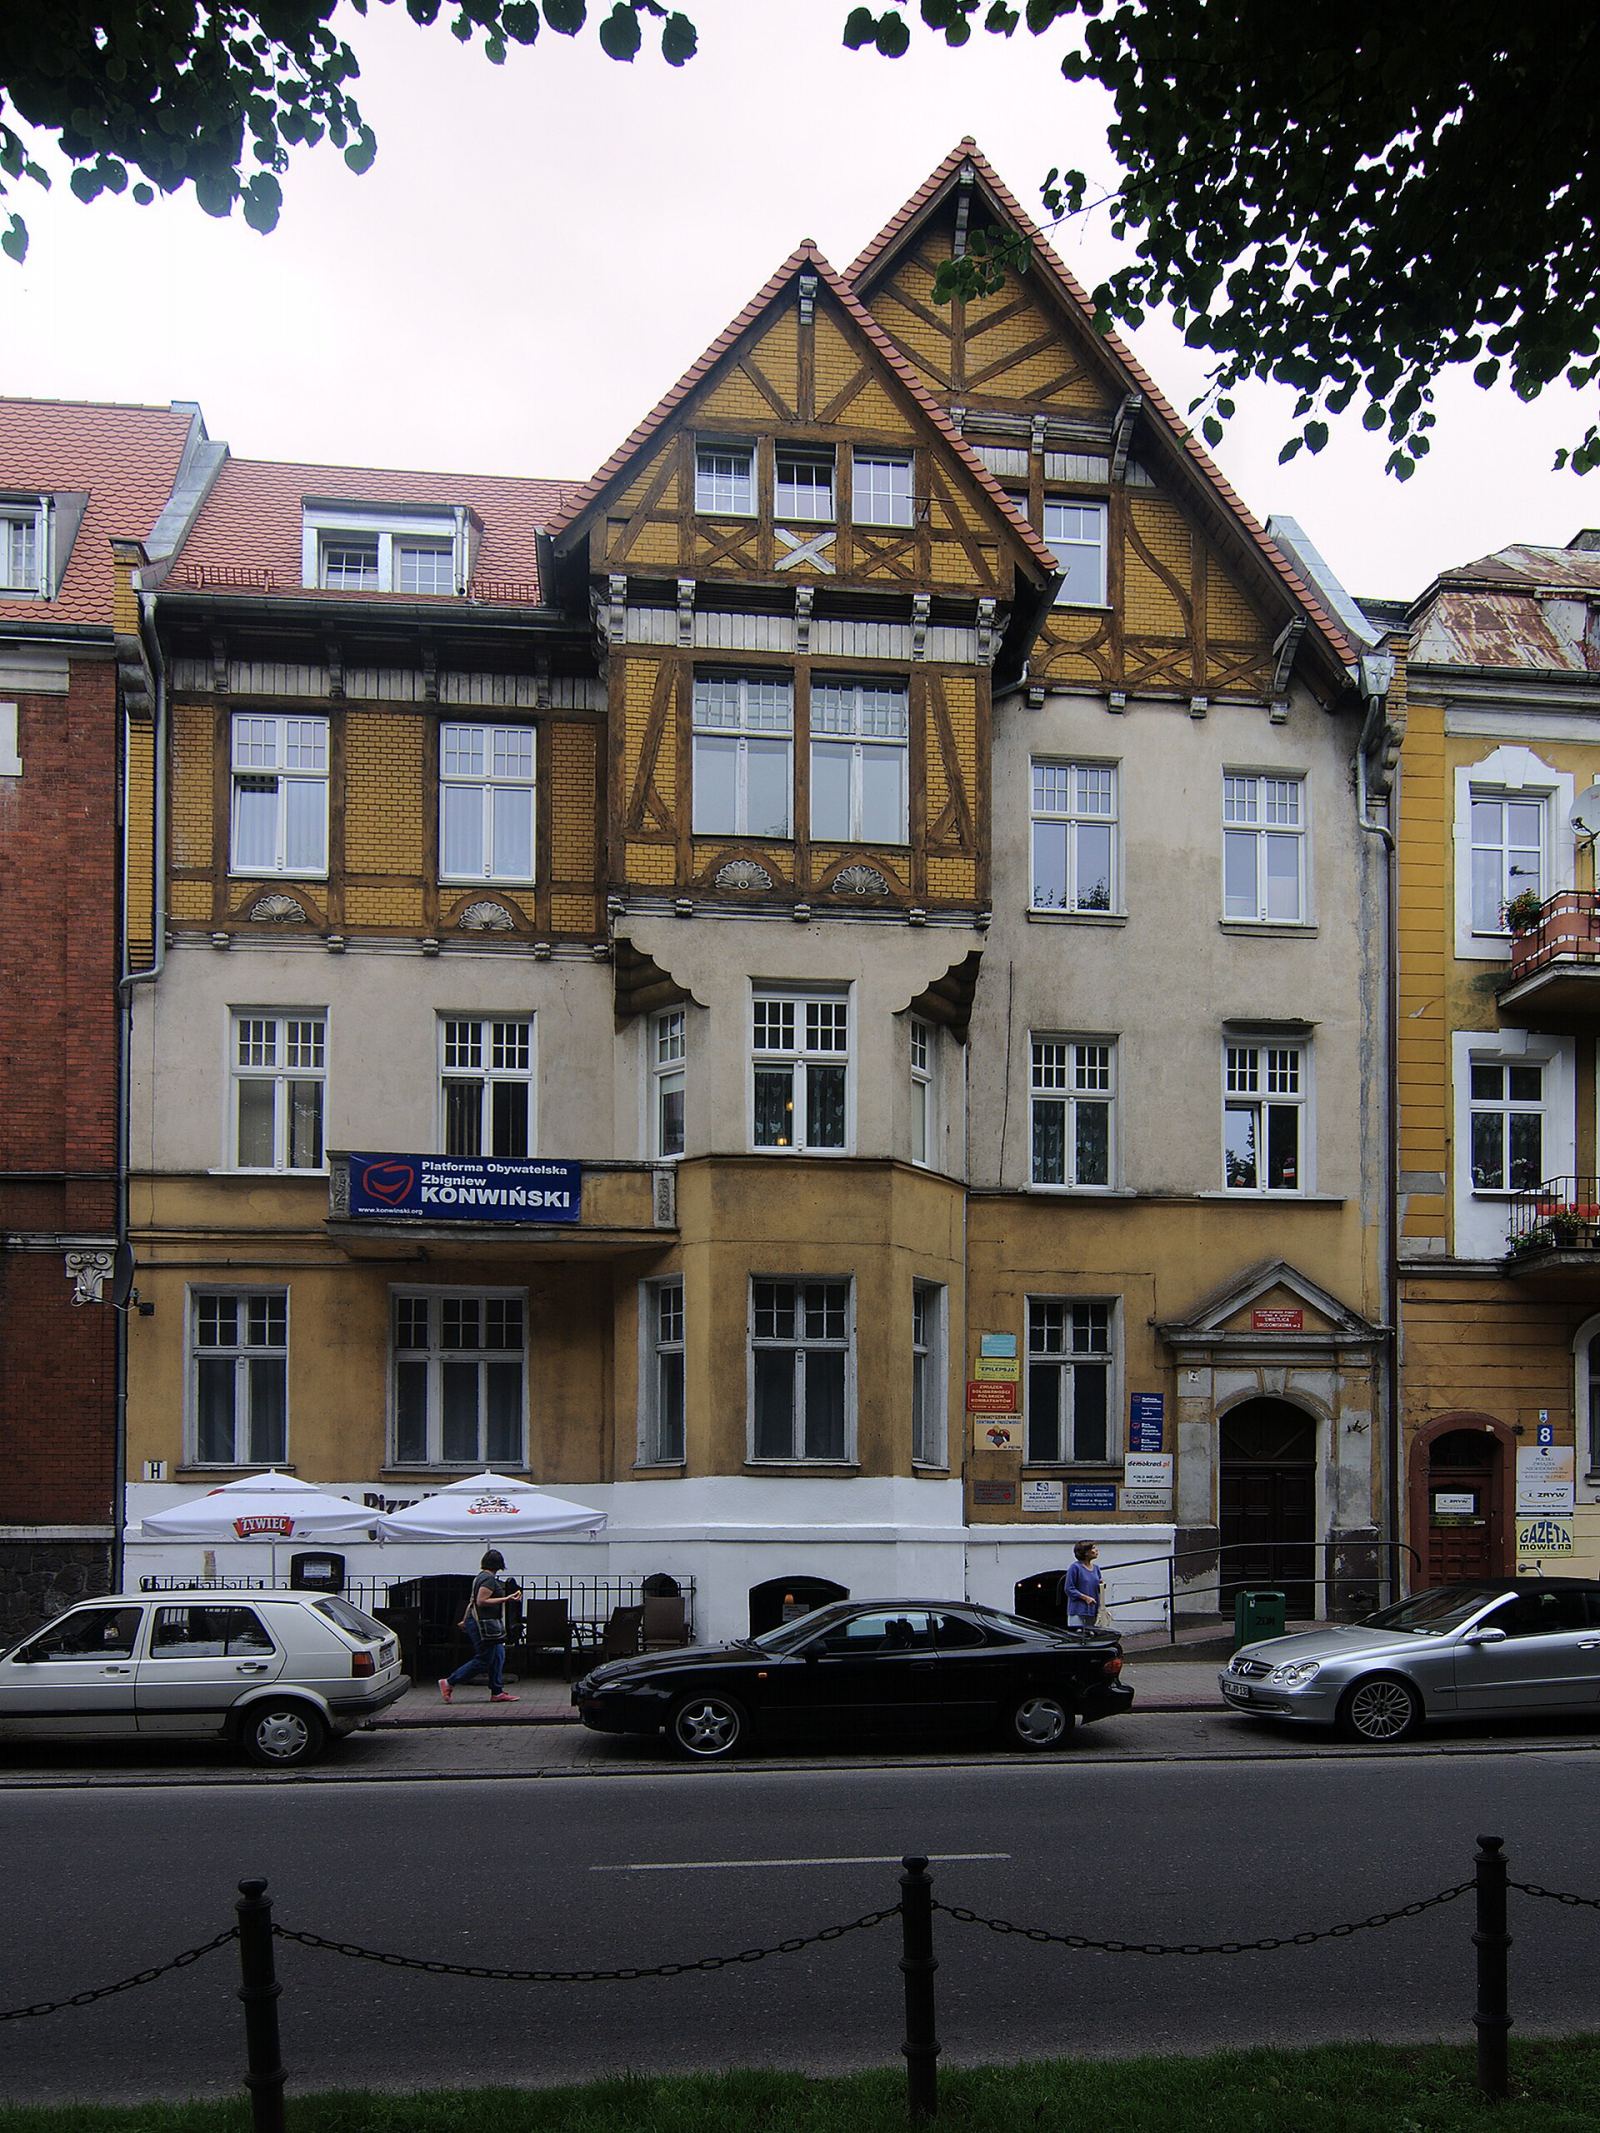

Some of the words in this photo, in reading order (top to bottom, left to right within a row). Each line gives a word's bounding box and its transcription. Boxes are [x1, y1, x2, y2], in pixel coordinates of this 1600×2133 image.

[421, 1161, 483, 1172] Platforma
[487, 1163, 568, 1175] Obywatelska
[421, 1174, 487, 1186] Zbigniew
[421, 1186, 570, 1208] KONWIŃSKI
[358, 1206, 424, 1215] www.konwinski.org
[1540, 1427, 1551, 1442] 8
[151, 1462, 160, 1479] H
[241, 1517, 287, 1531] ŻYWIEC
[1519, 1521, 1571, 1544] GAZETA
